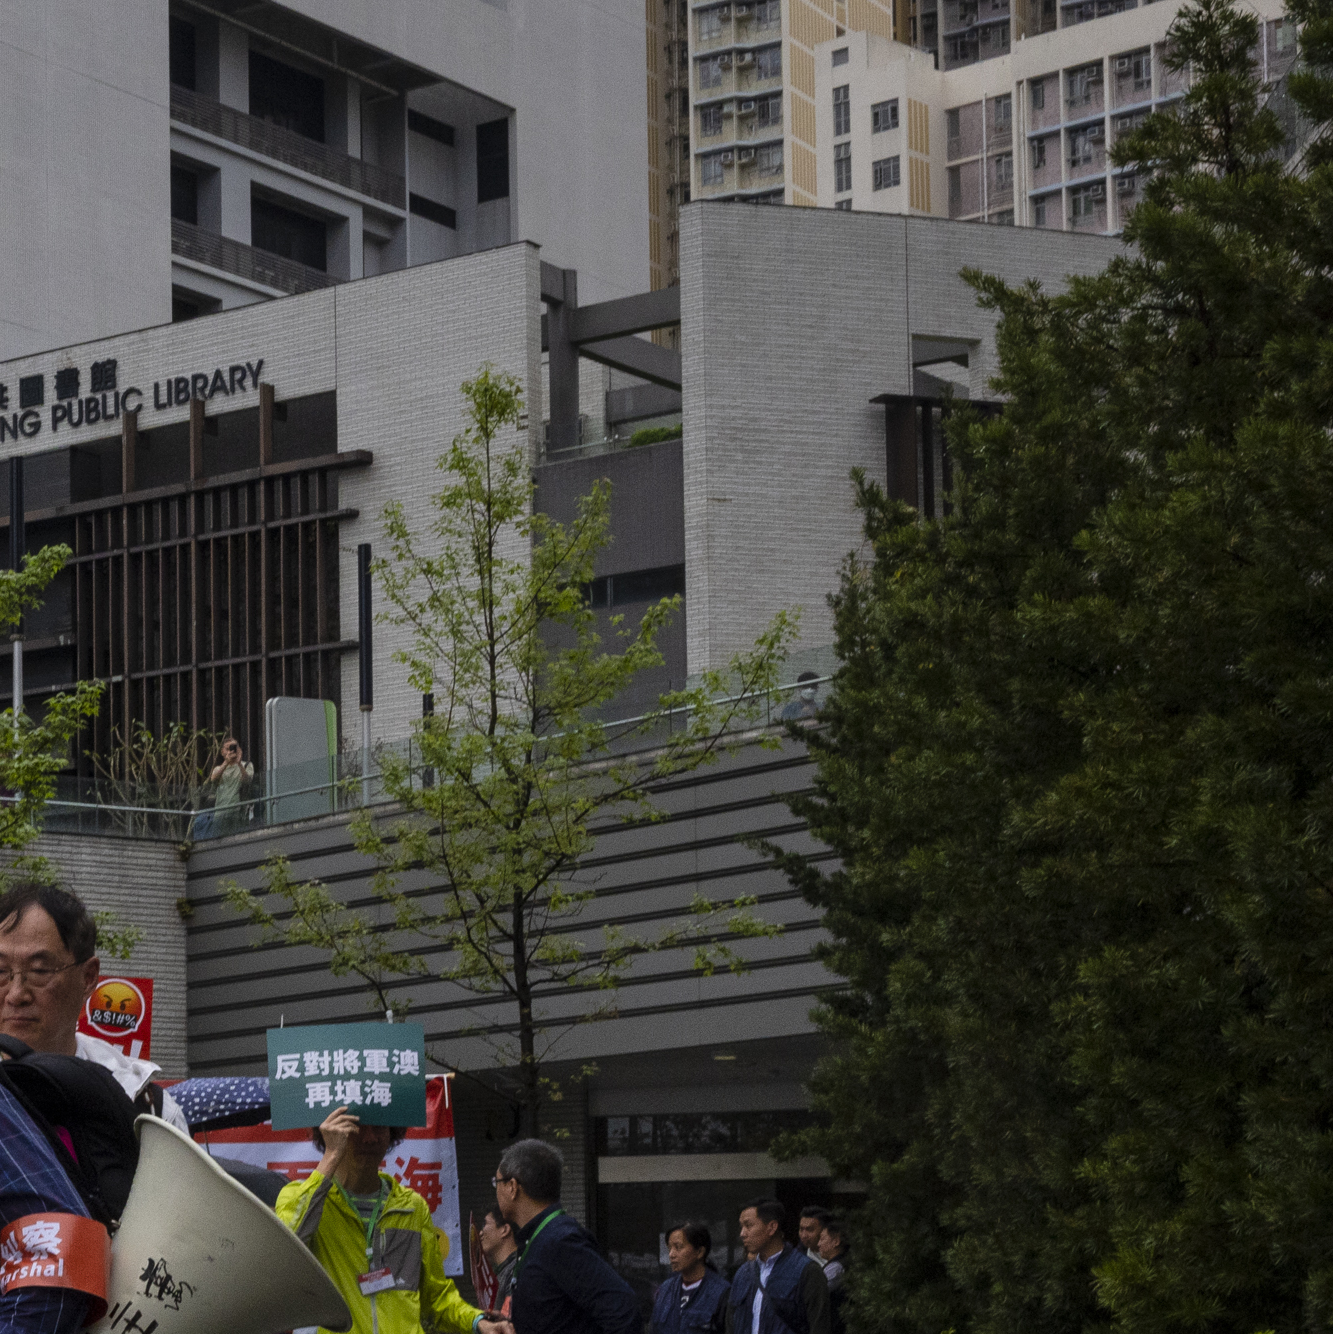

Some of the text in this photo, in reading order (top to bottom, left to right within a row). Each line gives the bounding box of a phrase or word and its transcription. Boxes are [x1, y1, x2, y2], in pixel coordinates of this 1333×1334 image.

[51, 387, 143, 432] PUBLIC
[153, 359, 265, 412] LIBRARY
[274, 1048, 420, 1080] 反對將軍澳
[305, 1079, 394, 1109] 再填海
